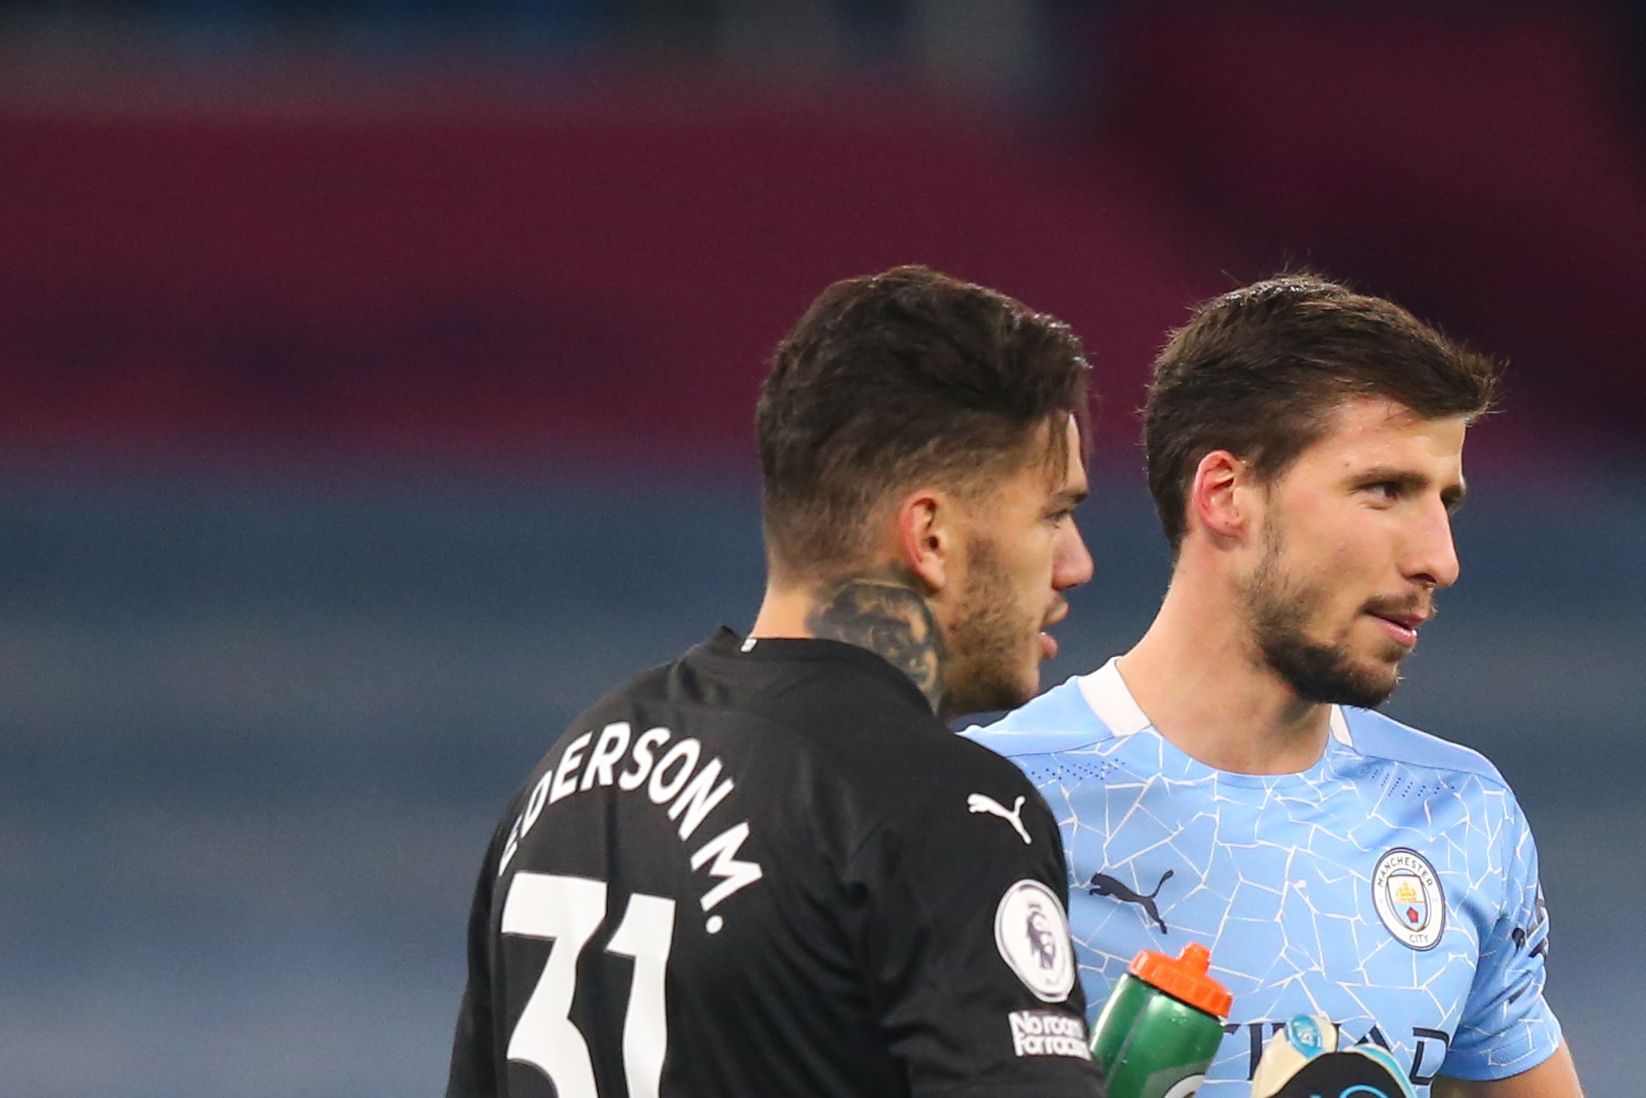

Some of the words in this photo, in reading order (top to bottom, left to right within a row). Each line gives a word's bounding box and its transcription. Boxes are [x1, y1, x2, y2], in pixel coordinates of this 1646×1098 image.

[499, 721, 735, 876] EDERSON
[690, 821, 763, 934] M.
[1377, 856, 1433, 888] MANCHESTER
[1409, 934, 1428, 944] CITY
[1008, 1010, 1042, 1035] No
